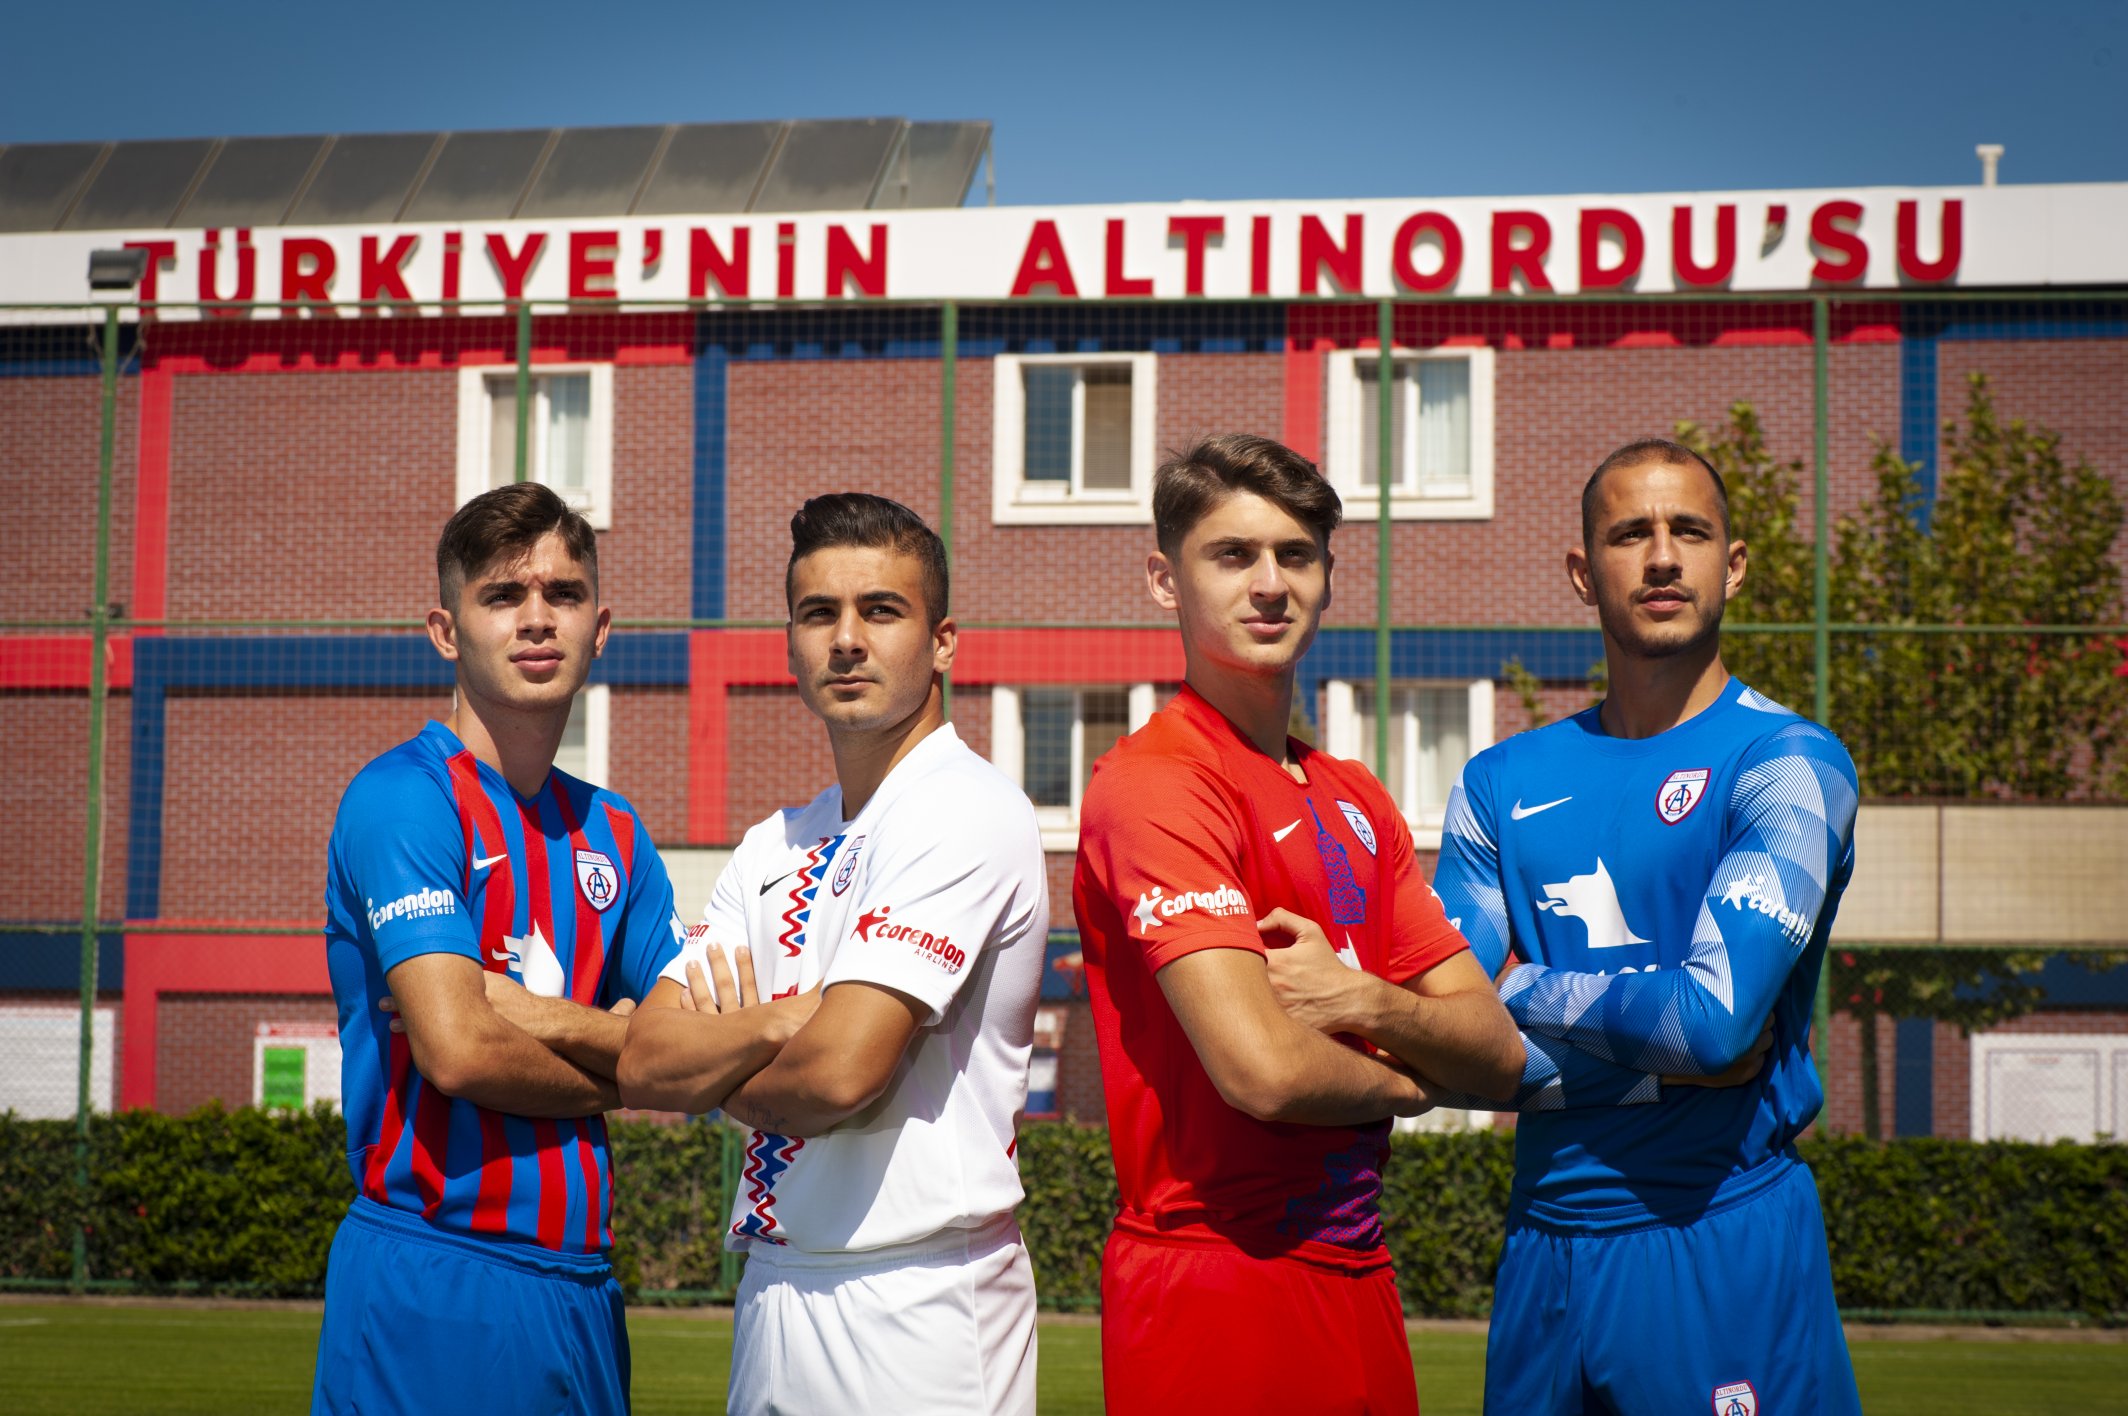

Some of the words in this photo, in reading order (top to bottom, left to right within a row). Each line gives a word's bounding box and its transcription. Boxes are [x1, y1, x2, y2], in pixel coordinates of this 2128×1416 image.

[124, 221, 889, 319] TÜRKİYE'NİN
[1009, 199, 1963, 298] ALTINORDU'SU
[373, 887, 455, 930] corendon
[407, 906, 456, 921] AIRLINES
[1748, 896, 1809, 936] coren
[876, 923, 965, 967] corendon
